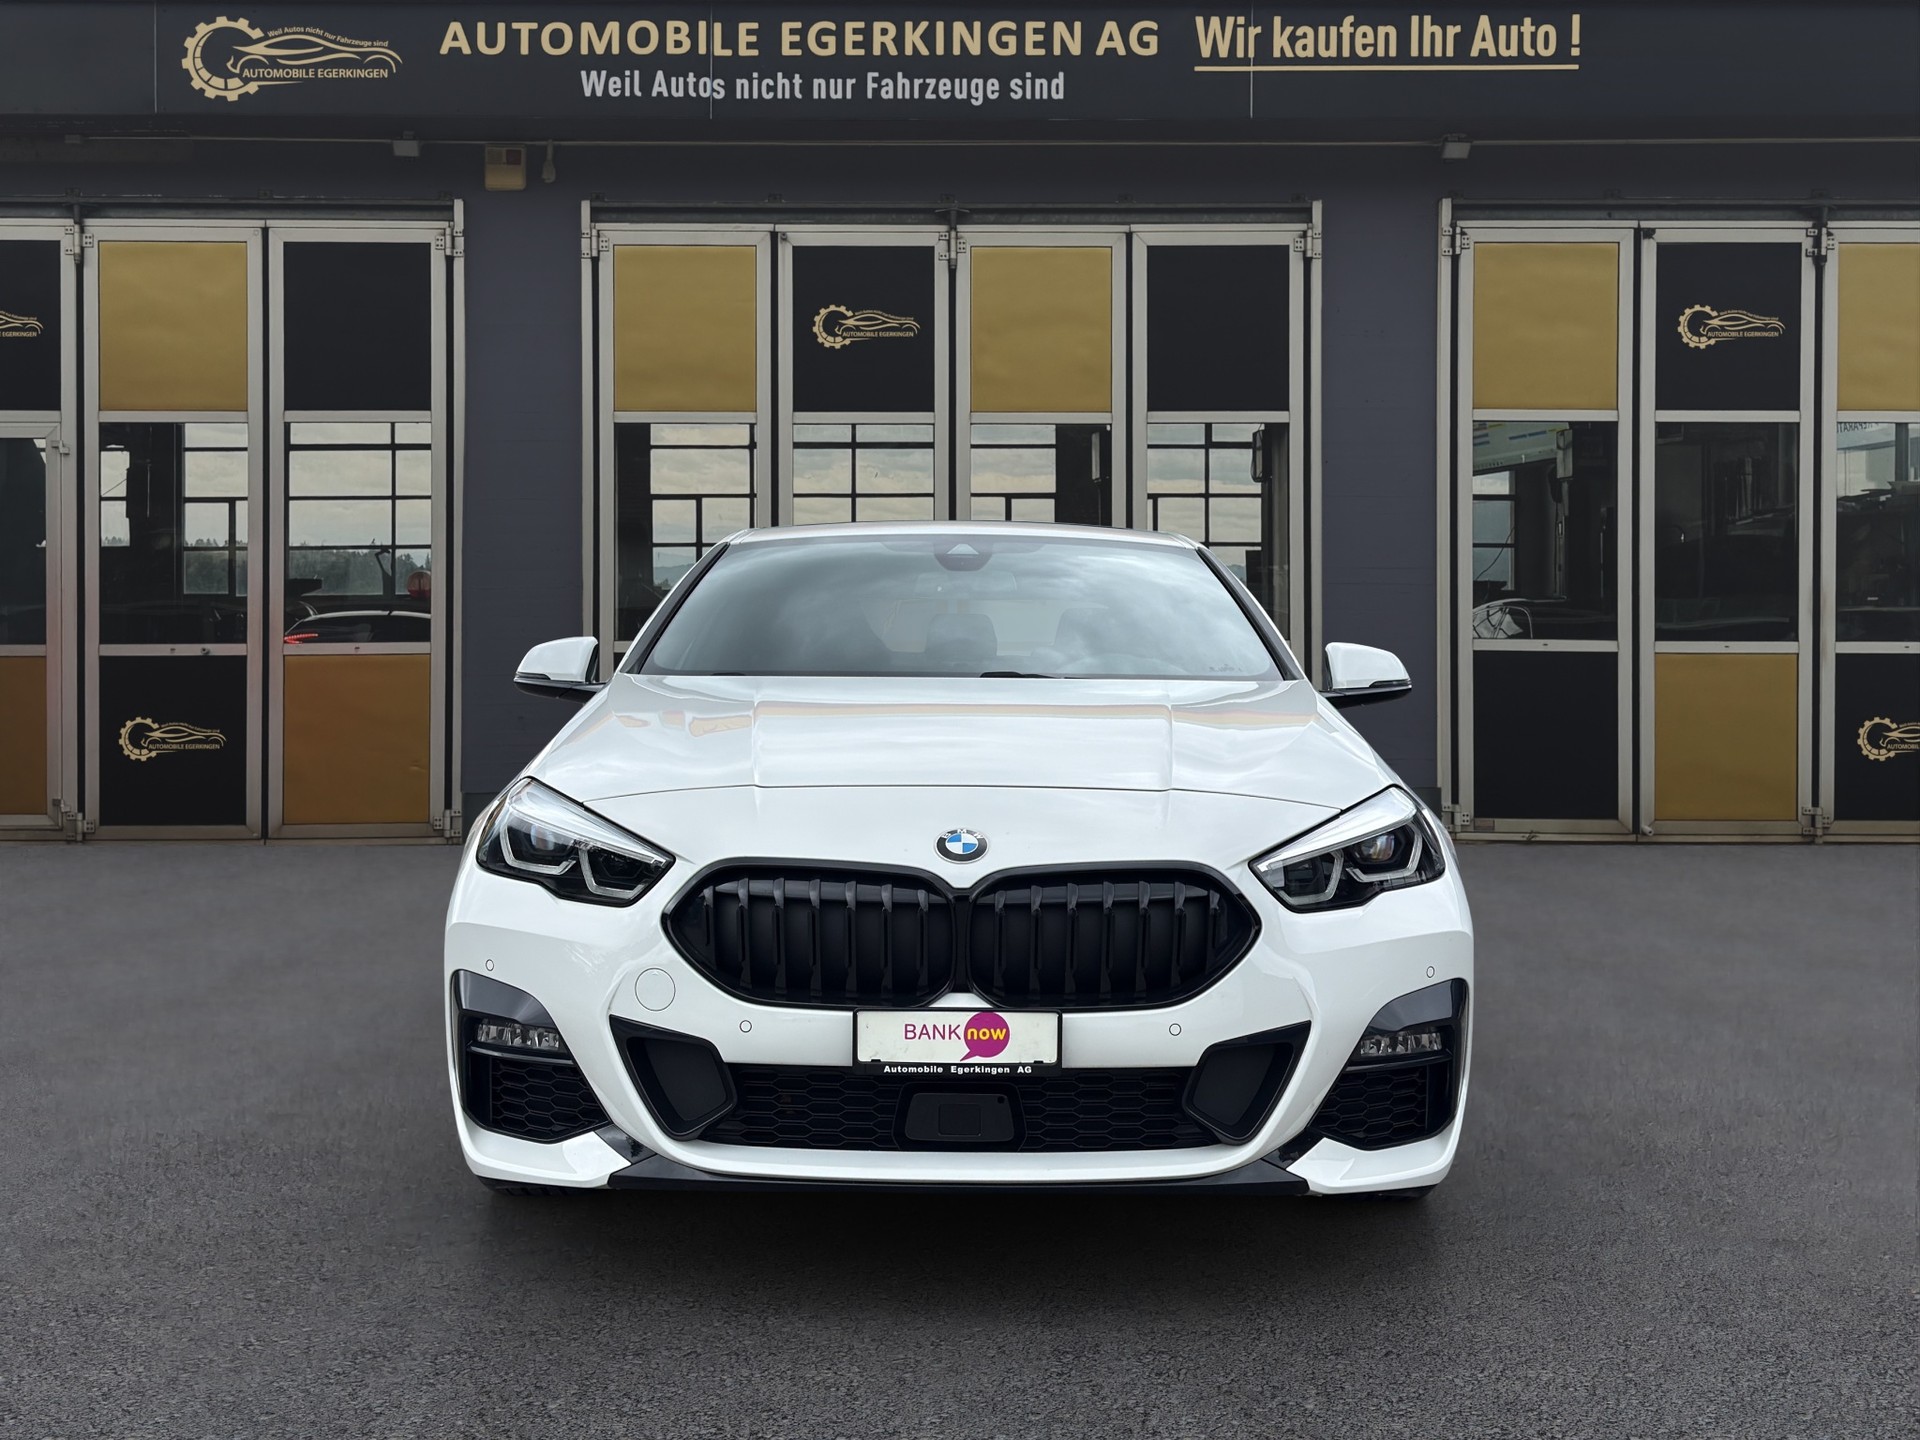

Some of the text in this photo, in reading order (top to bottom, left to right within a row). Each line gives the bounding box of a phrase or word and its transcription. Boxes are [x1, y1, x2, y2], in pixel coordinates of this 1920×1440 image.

[267, 28, 283, 37] Weil
[305, 26, 324, 36] nicht
[324, 31, 337, 41] nur
[336, 35, 372, 48] Fahrzeuge
[373, 40, 389, 48] sind
[439, 20, 1159, 57] AUTOMOBILE EGERKINGEN AG
[1194, 15, 1262, 58] Wir
[1272, 15, 1397, 58] kaufen
[1410, 14, 1462, 57] Ihr
[1469, 14, 1557, 57] Auto
[242, 68, 389, 79] AUTOMOBILE EGERKINGEN
[580, 69, 1065, 106] Weil Autos nicht nur Fahrzeuge sind
[904, 1023, 1006, 1041] BANK now
[883, 1065, 1032, 1075] Automobile Egerkingen AG
